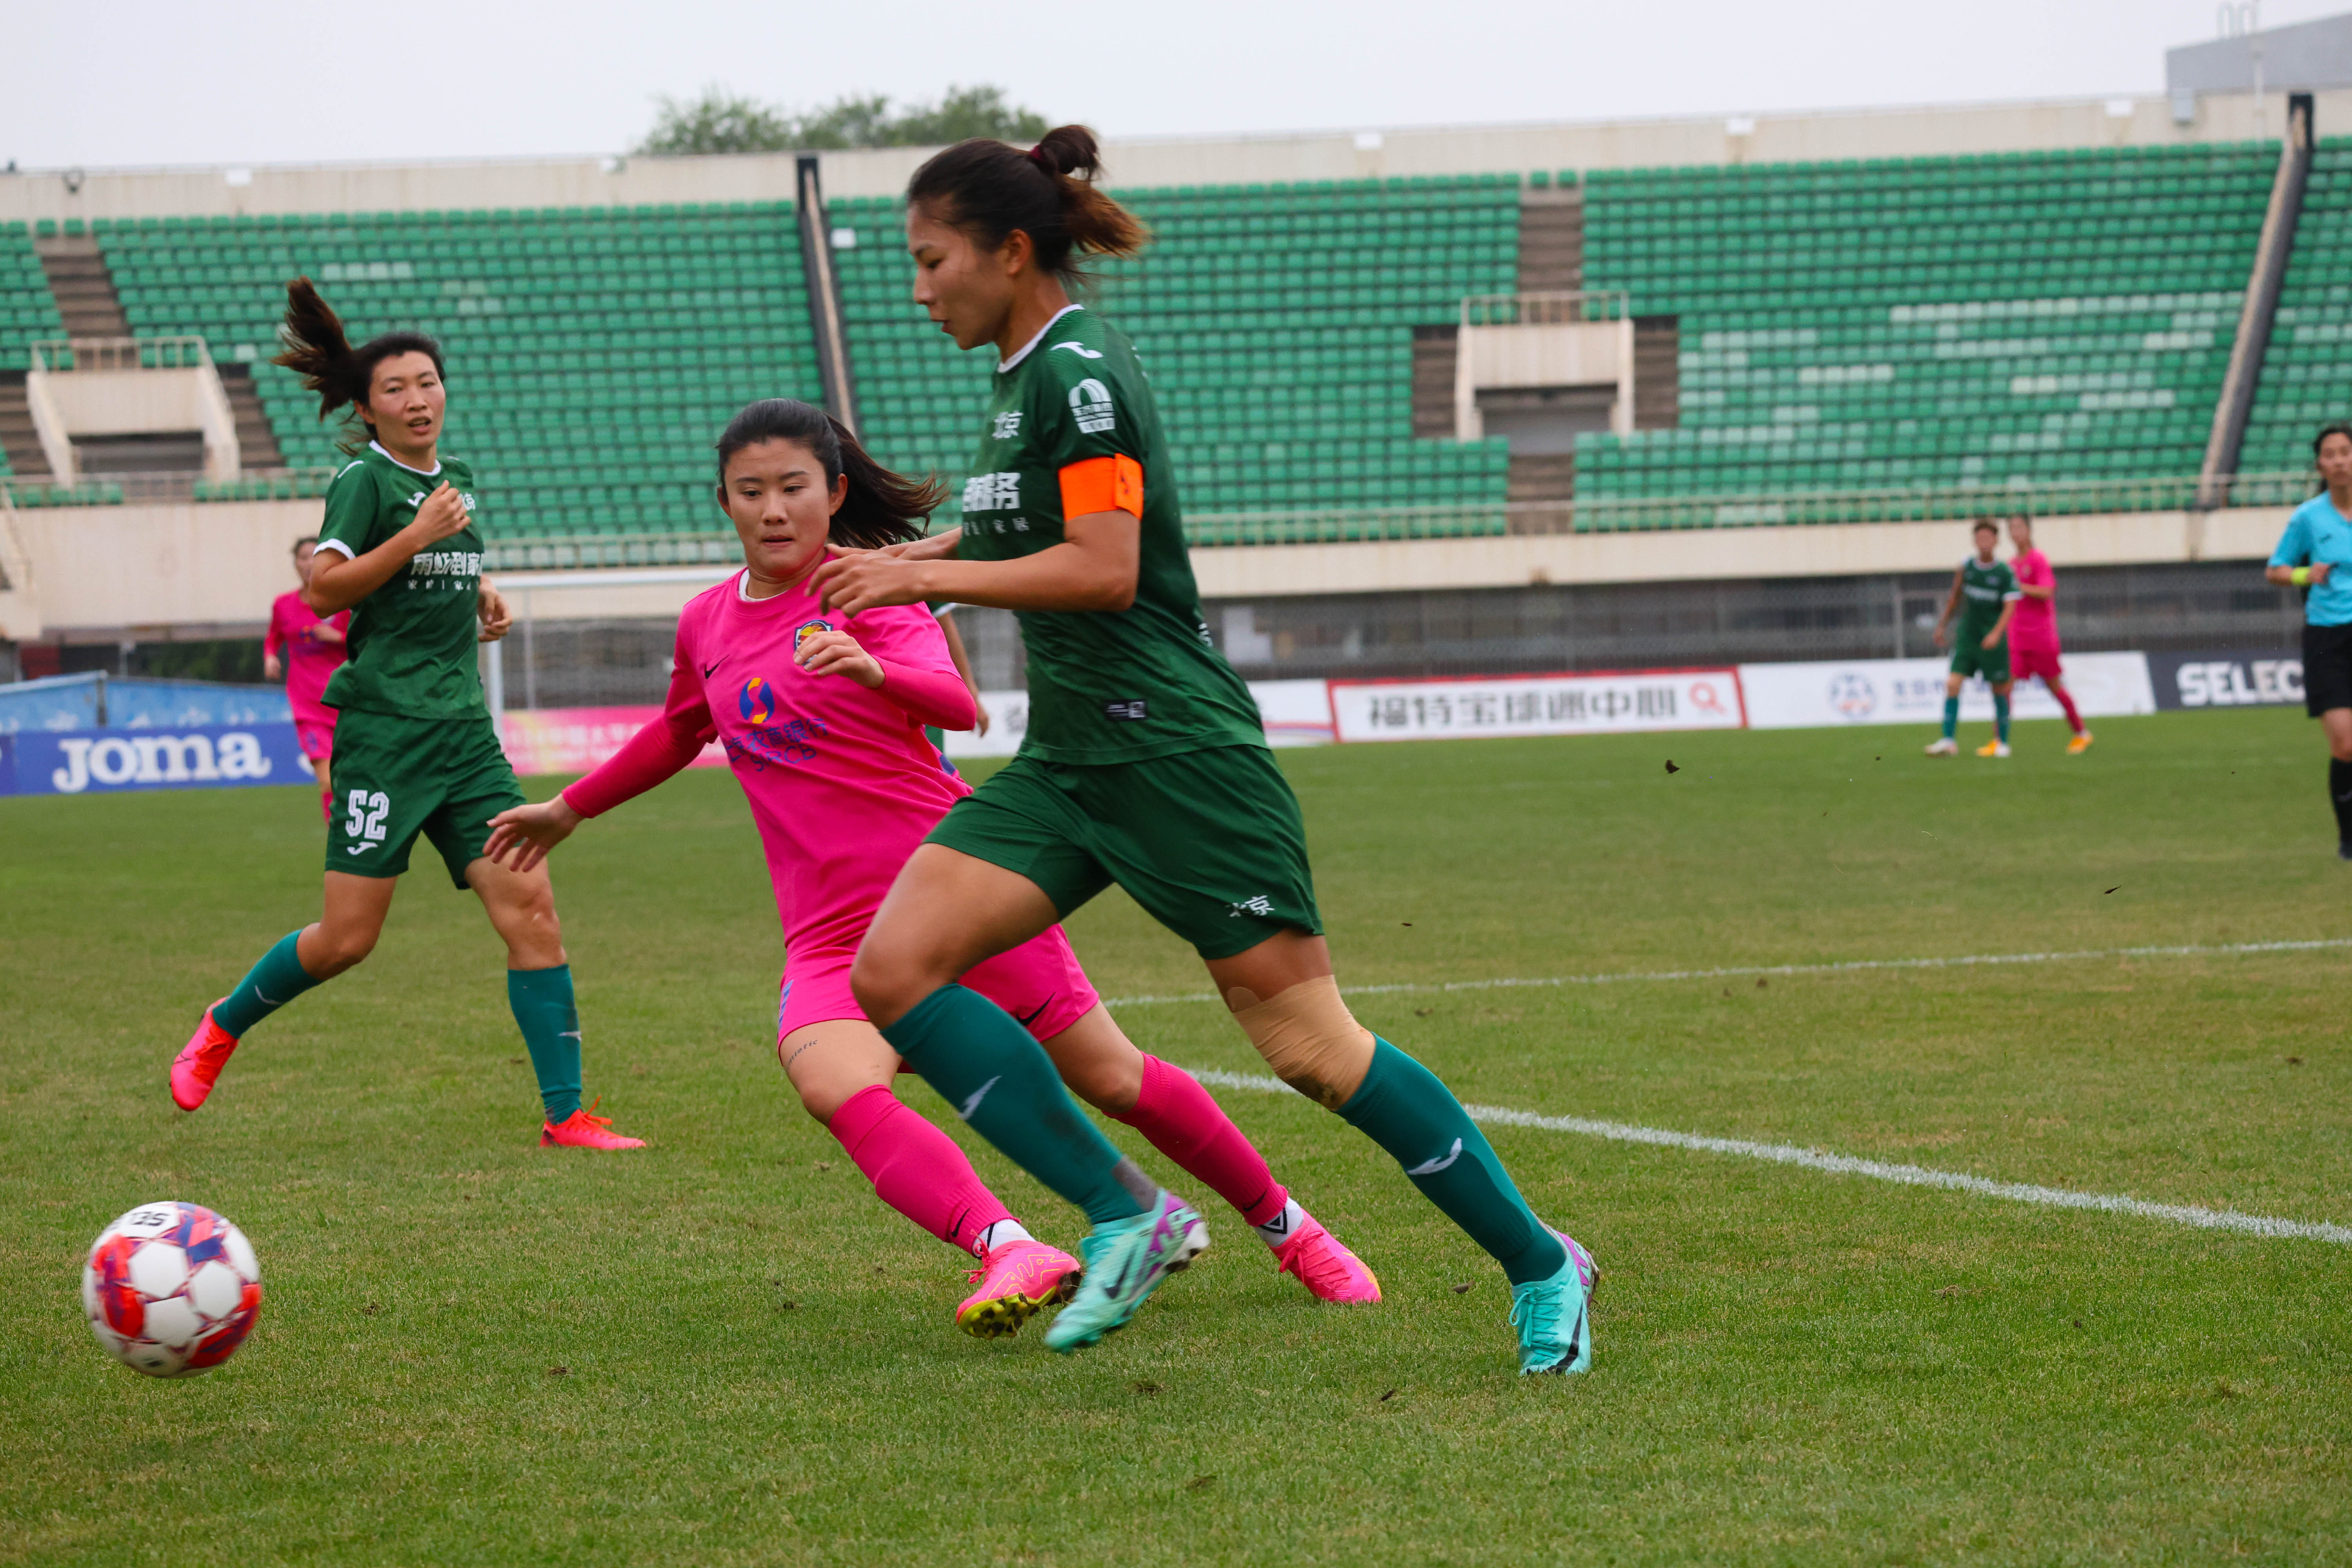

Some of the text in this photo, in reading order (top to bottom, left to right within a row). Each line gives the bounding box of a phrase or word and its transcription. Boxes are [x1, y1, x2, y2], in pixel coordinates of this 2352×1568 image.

[411, 552, 483, 575] 雨虹到家
[2176, 659, 2307, 707] SELEC
[345, 789, 390, 840] 52
